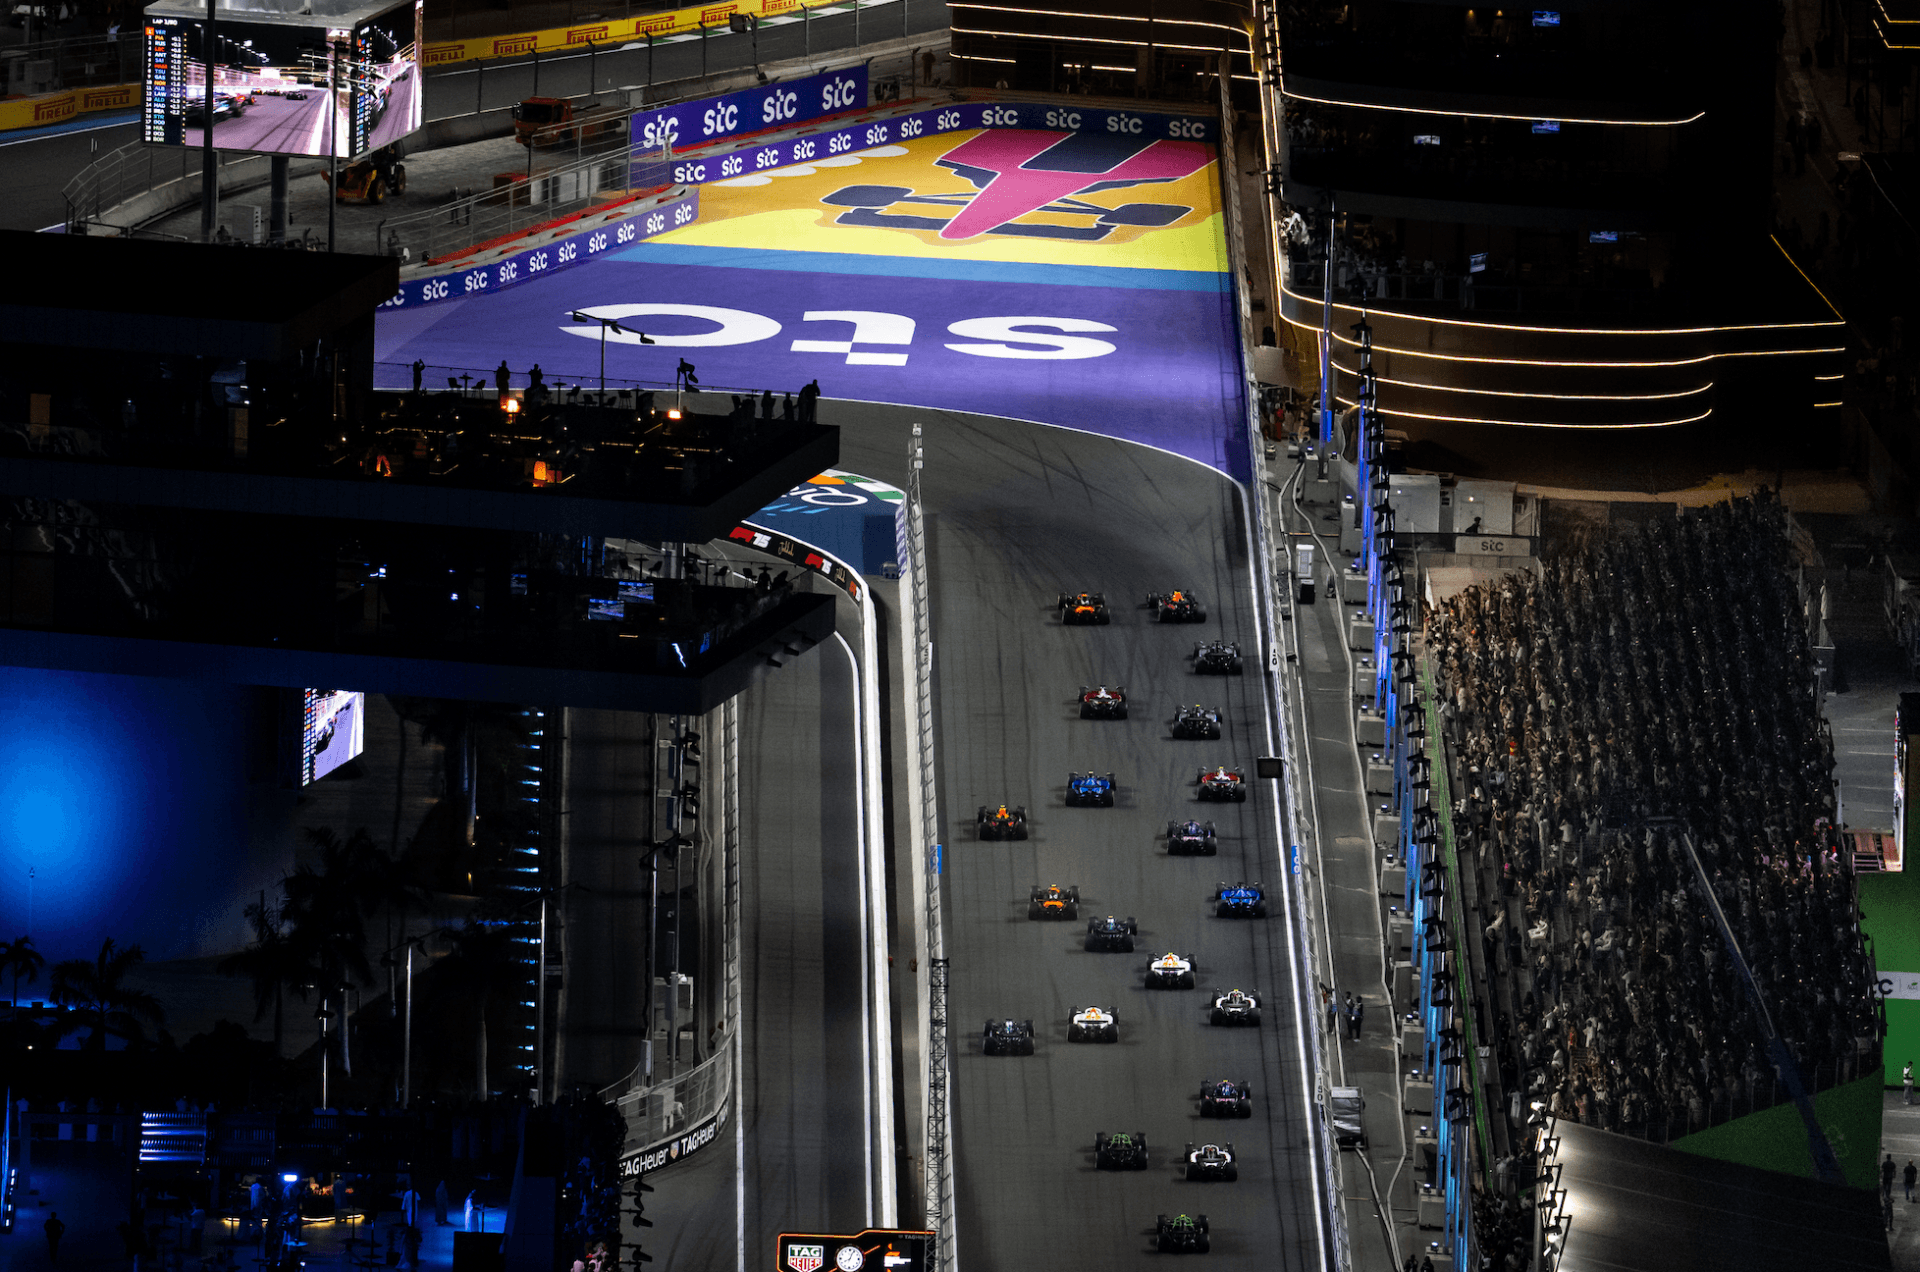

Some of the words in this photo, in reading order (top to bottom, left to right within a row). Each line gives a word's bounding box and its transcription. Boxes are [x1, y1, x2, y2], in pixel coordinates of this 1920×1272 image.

[493, 36, 538, 55] PIRELLI
[566, 26, 608, 45] PIRELLI
[635, 16, 675, 35] PIRELLI
[701, 5, 738, 24] PIREL
[34, 95, 76, 120] PIRELLI
[83, 89, 130, 109] PIRELLI
[643, 114, 678, 149] stc
[703, 101, 738, 135] stc
[763, 89, 797, 123] stc
[822, 76, 856, 110] stc
[674, 162, 706, 185] stc
[722, 155, 743, 177] stc
[756, 148, 779, 169] stc
[793, 139, 815, 161] stc
[829, 132, 852, 154] stc
[866, 124, 888, 145] stc
[901, 117, 923, 138] stc
[937, 110, 961, 131] stc
[981, 106, 1018, 126] stc
[1045, 108, 1082, 129] stc
[1106, 113, 1143, 134] stc
[1168, 118, 1205, 138] stc
[423, 279, 449, 301] stc
[465, 270, 488, 292] stc
[499, 261, 517, 283] stc
[529, 251, 548, 273] stc
[558, 241, 577, 263] stc
[588, 232, 607, 254] stc
[617, 222, 635, 244] stc
[646, 212, 665, 234] stc
[675, 203, 692, 225] stc
[1481, 539, 1504, 551] stc
[789, 1257, 822, 1272] HEUER
[793, 1247, 820, 1257] TAG
